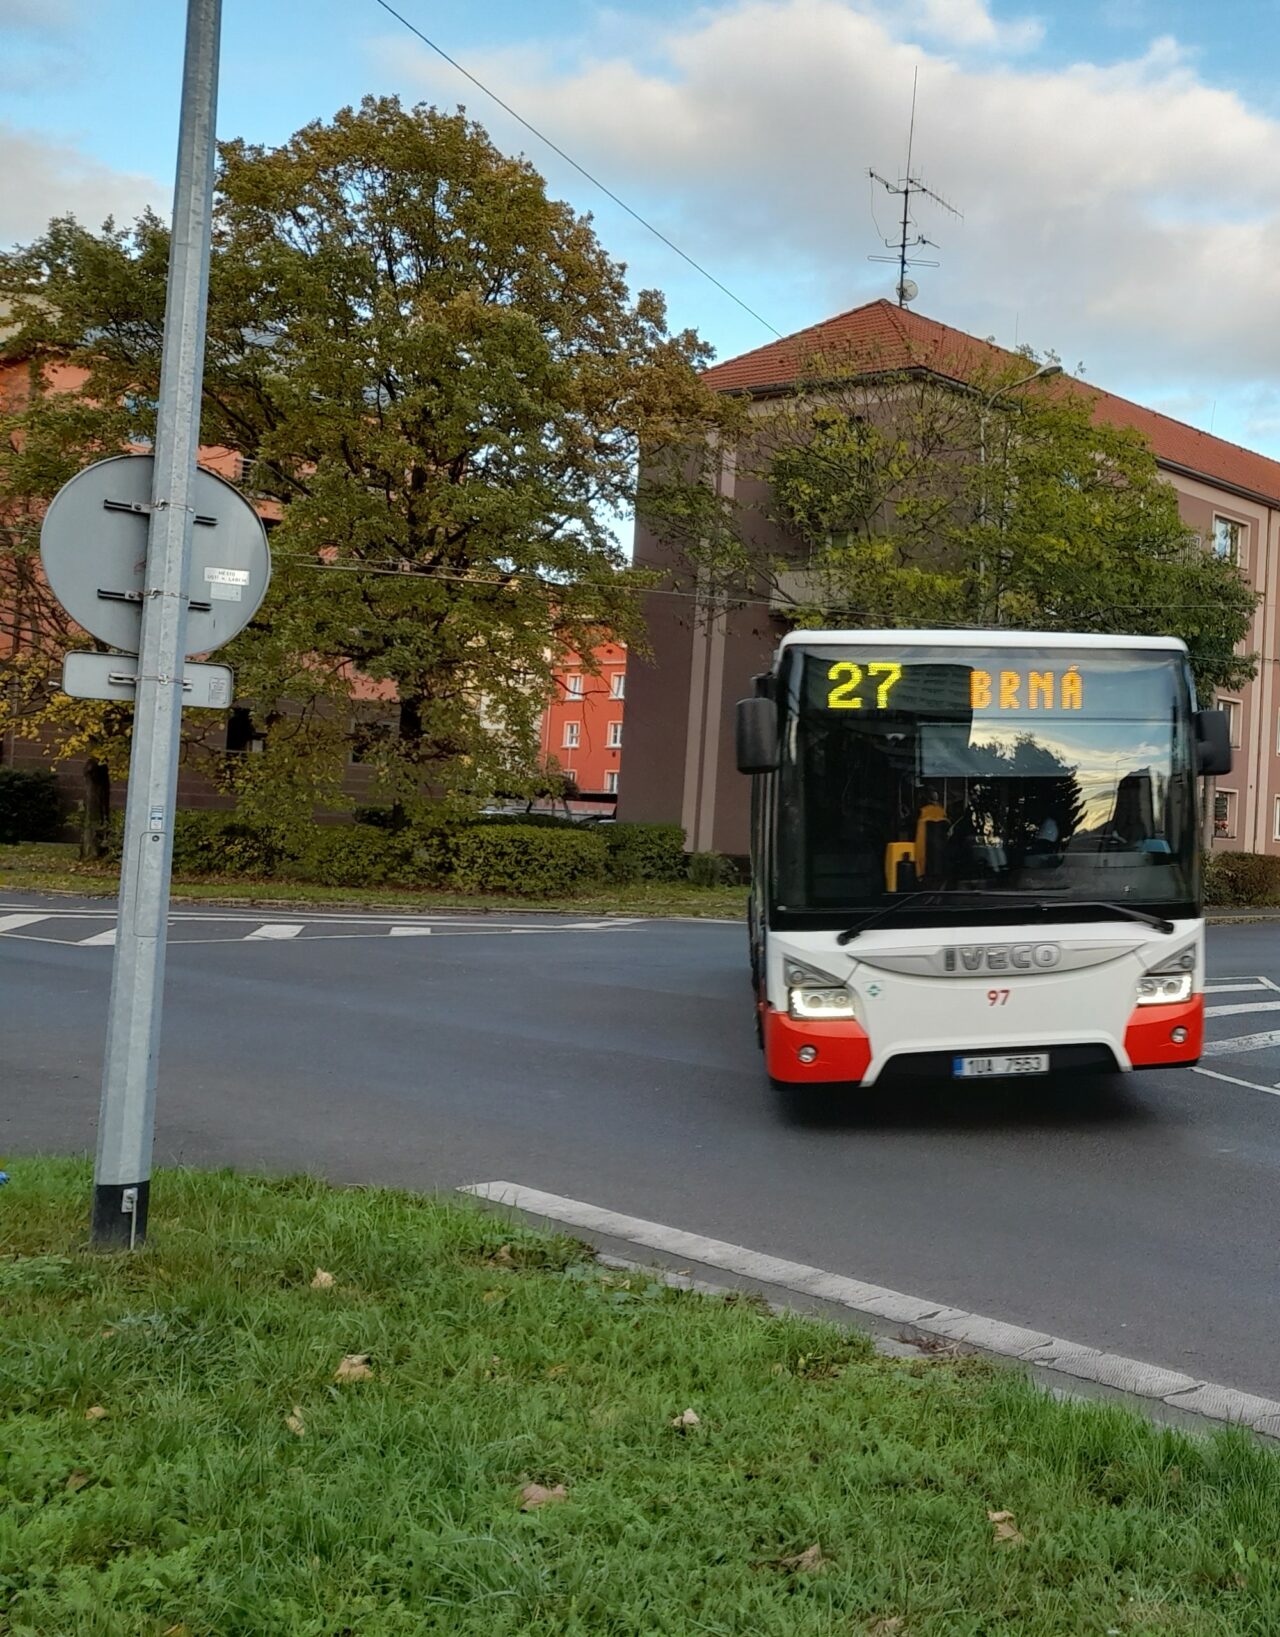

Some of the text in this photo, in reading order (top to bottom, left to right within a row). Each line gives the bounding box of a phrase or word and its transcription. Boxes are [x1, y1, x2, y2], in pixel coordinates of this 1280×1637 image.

[828, 661, 902, 709] 27
[944, 944, 1060, 971] IVECO
[987, 989, 1010, 1007] 97
[968, 1056, 1042, 1074] 1UA 7553
